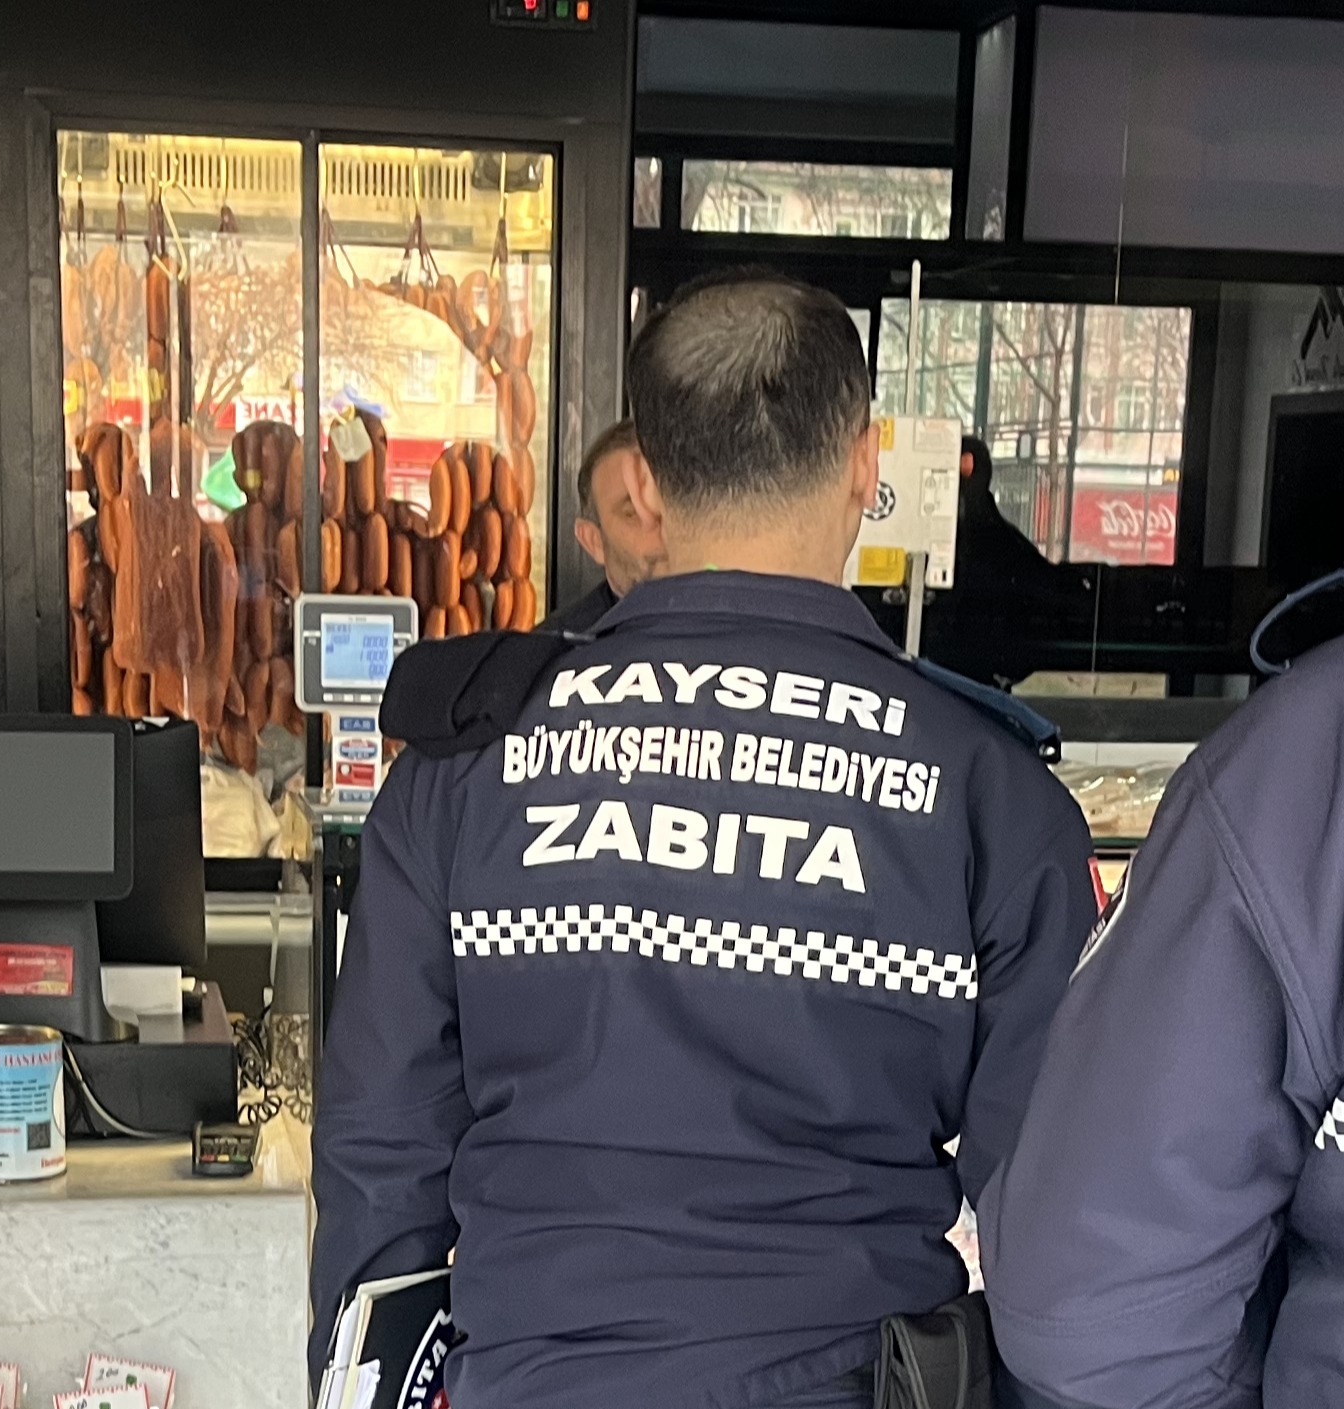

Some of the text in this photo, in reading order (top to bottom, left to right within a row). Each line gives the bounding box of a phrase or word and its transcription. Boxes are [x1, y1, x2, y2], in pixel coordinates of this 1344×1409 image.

[547, 661, 907, 737] KAYSERİ
[502, 719, 942, 814] BÜYÜKŞEHİR BELEDİYESİ
[522, 800, 867, 894] ZABITA
